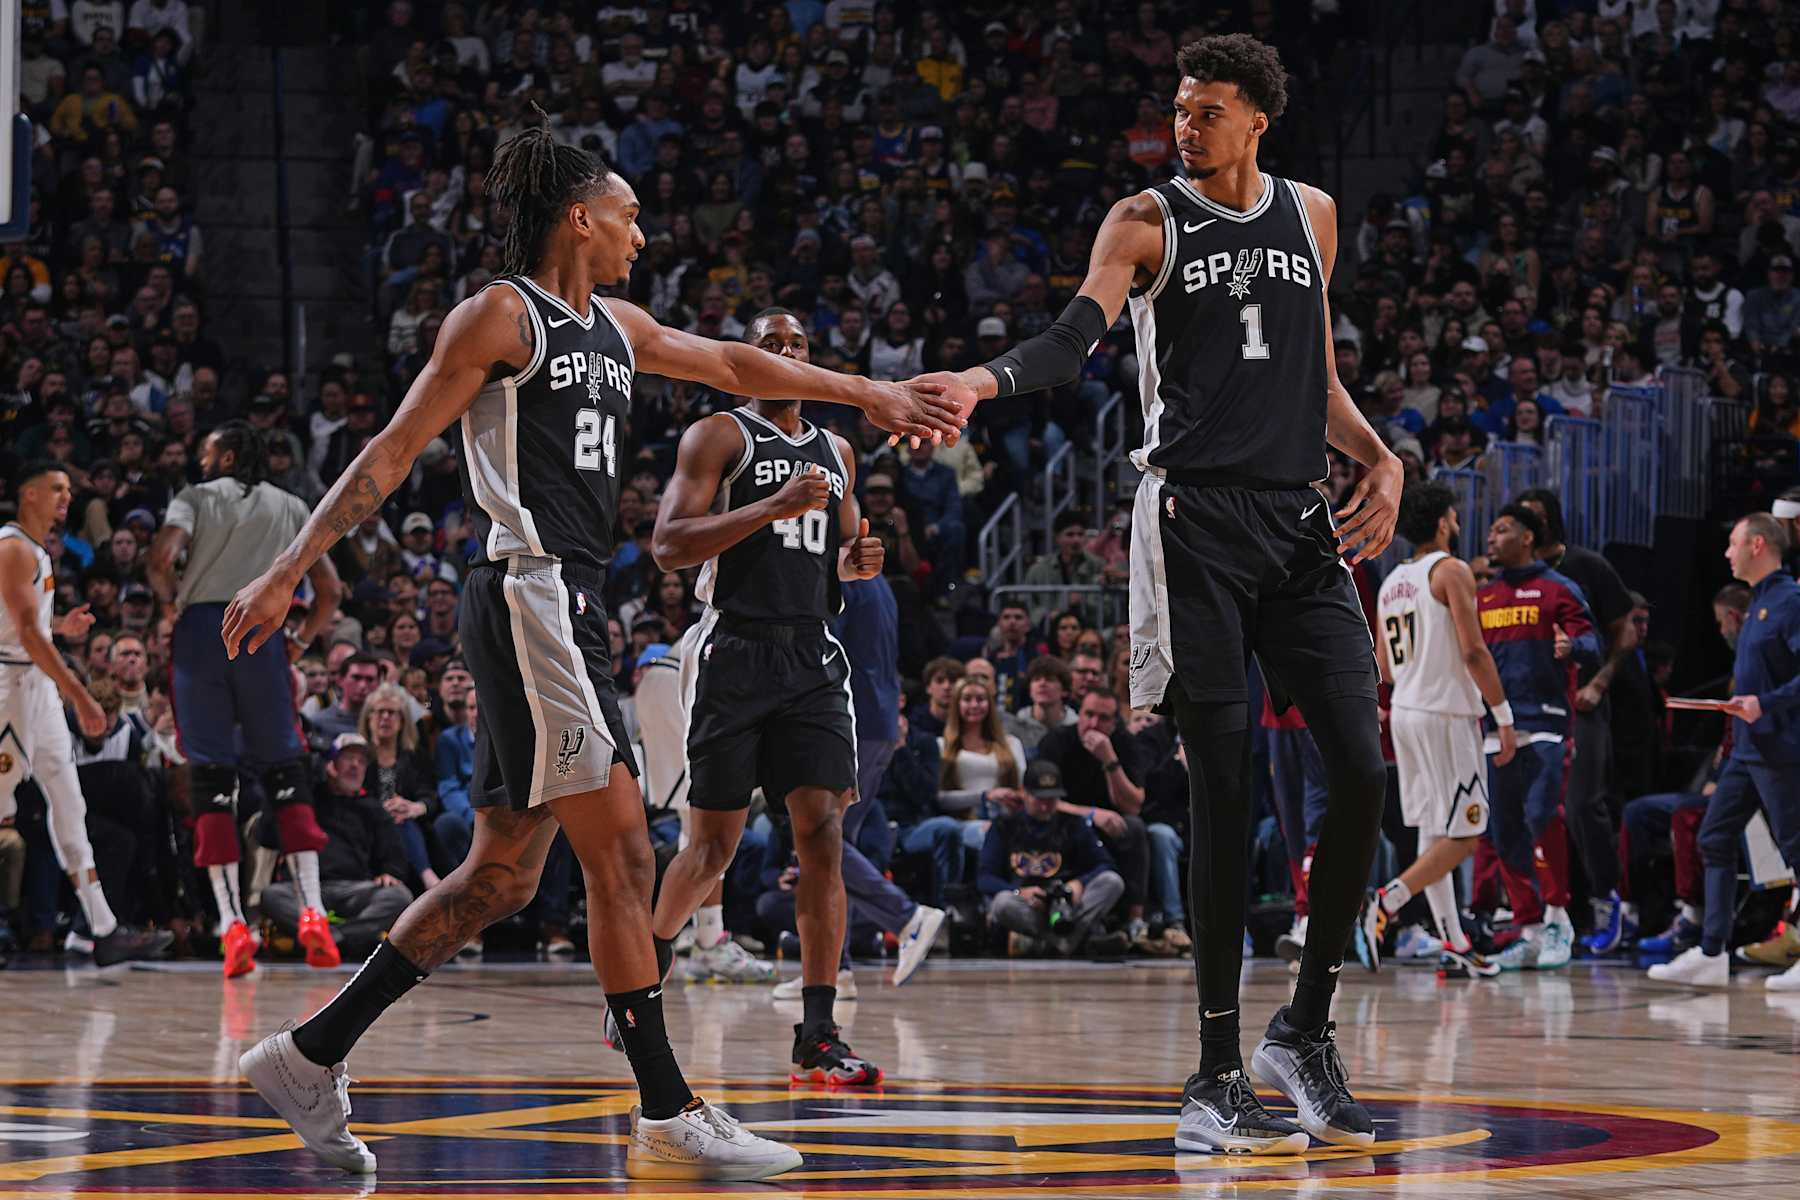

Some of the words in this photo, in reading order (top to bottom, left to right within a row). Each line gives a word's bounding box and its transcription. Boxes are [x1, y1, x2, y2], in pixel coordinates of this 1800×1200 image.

[1183, 248, 1312, 300] SPURS
[1240, 304, 1270, 359] 1
[550, 351, 633, 405] SPURS
[574, 407, 616, 478] 24
[772, 509, 829, 555] 40
[1480, 605, 1540, 629] NUGGETS
